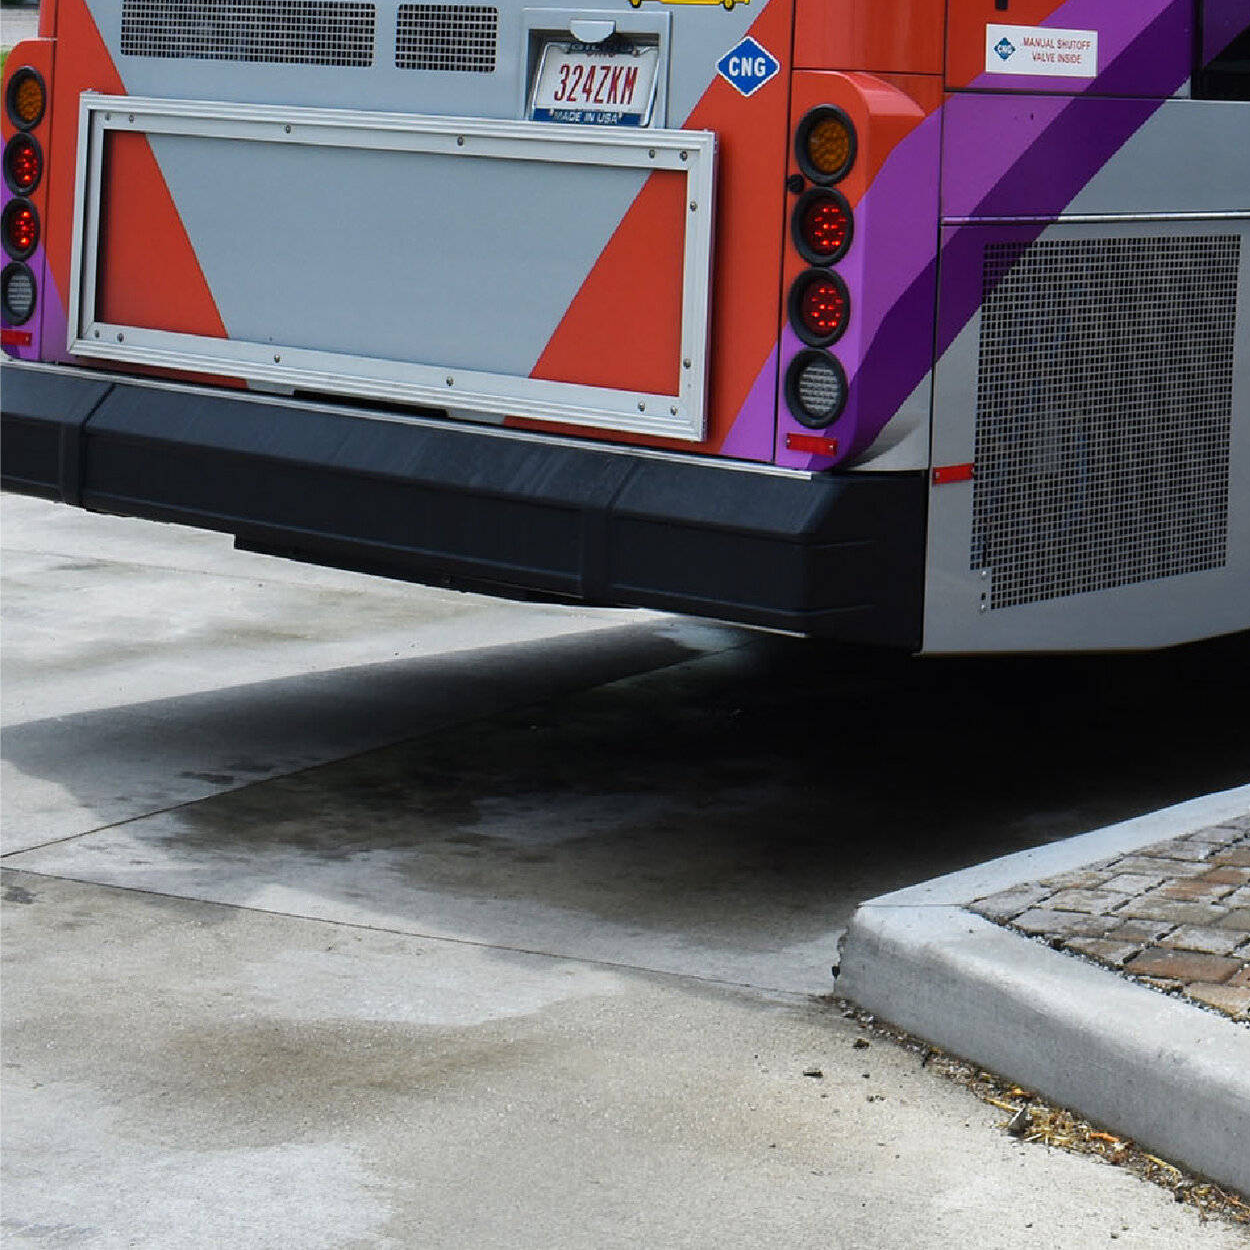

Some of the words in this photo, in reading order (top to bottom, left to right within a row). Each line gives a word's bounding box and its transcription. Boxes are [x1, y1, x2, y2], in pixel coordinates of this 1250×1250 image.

[1023, 37, 1055, 49] MANUAL
[1057, 38, 1091, 50] SHUTOFF
[1032, 51, 1056, 63] VALVE
[1057, 53, 1083, 64] INSIDE
[728, 56, 767, 77] CNG
[554, 111, 581, 122] MADE
[583, 112, 596, 123] IN
[596, 112, 618, 124] USA
